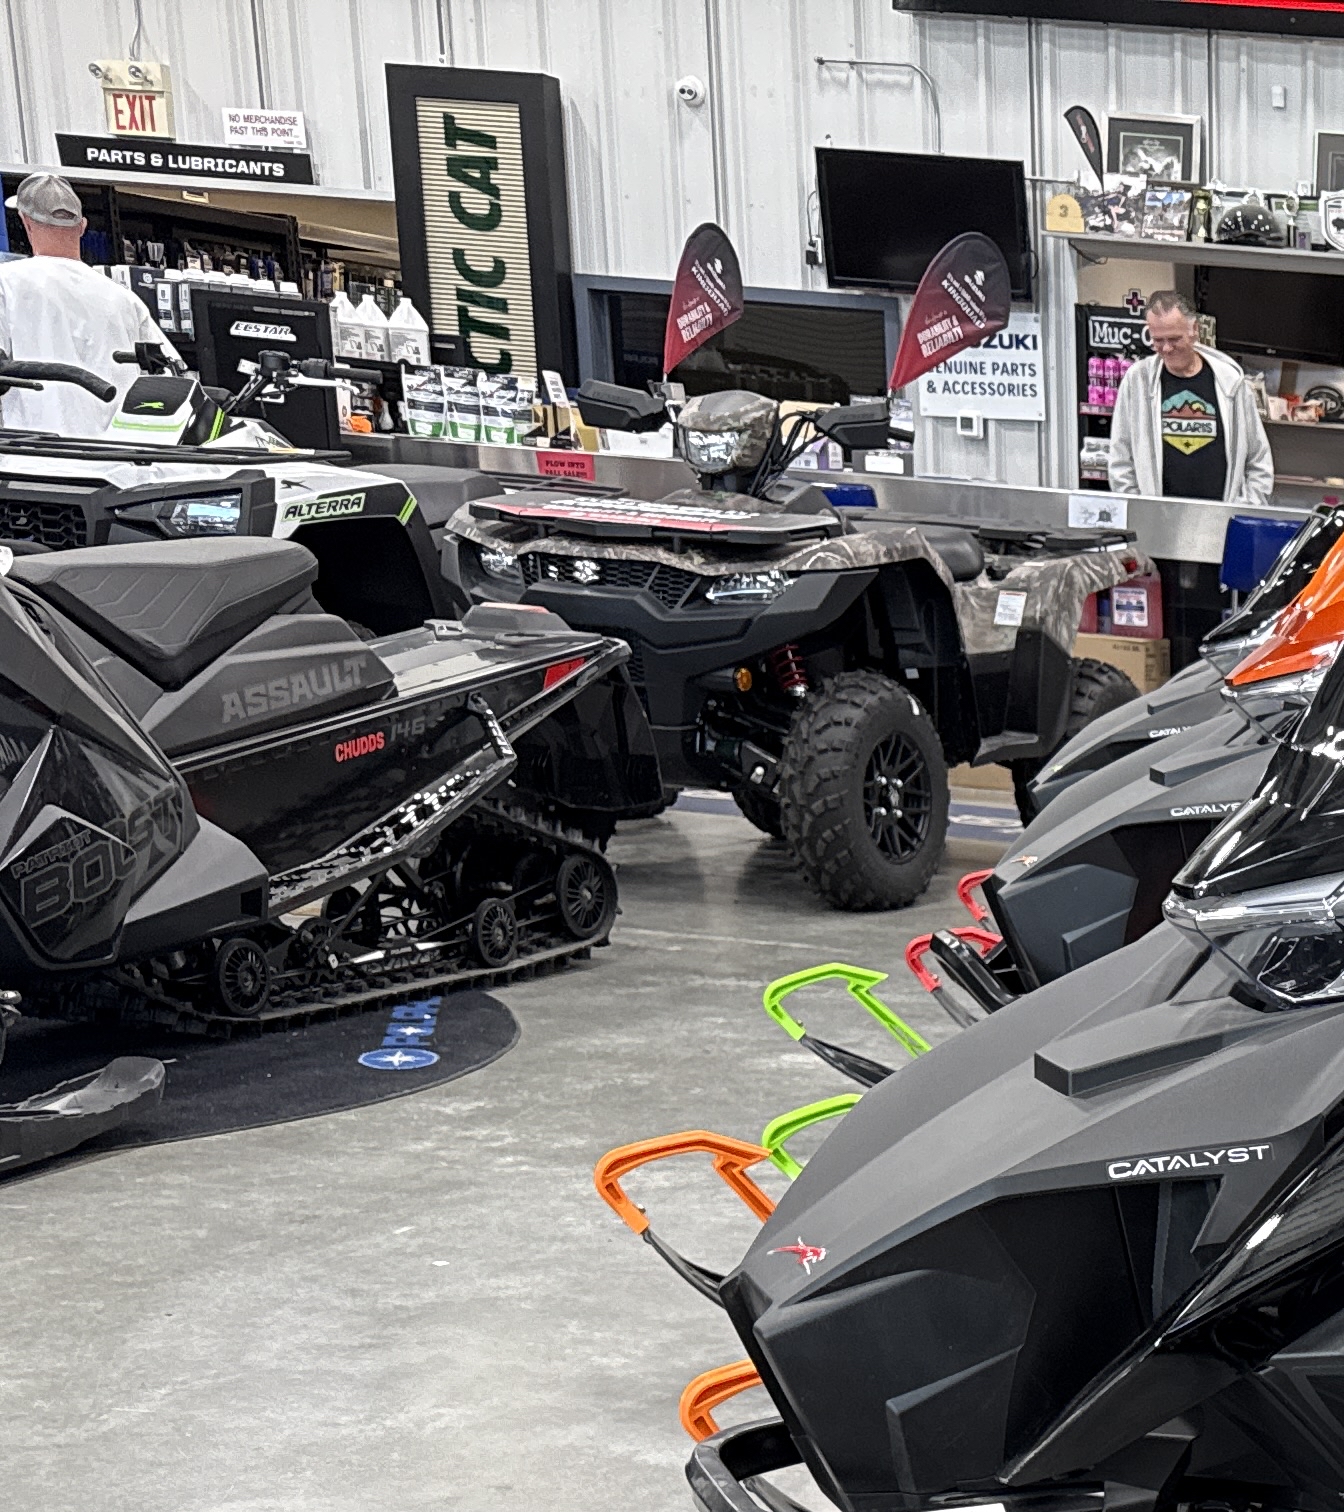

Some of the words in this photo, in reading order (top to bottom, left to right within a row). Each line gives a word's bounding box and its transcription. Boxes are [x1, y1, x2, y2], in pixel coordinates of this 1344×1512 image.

[112, 93, 156, 132] EXIT
[243, 114, 298, 126] MERCHANDISE
[87, 148, 145, 166] PARTS
[151, 153, 163, 167] &
[168, 155, 285, 177] LUBRICANTS
[443, 113, 502, 232] CAT
[928, 361, 990, 376] ENUINE
[991, 361, 1037, 378] PARTS
[926, 380, 937, 394] &
[942, 380, 1038, 398] ACCESSORIES
[284, 496, 364, 518] ALTERRA
[221, 654, 368, 724] ASSAULT
[335, 731, 385, 763] CHUDDS
[390, 716, 426, 742] 146
[10, 829, 92, 879] PATRIOT
[1107, 1144, 1270, 1179] CATALYST
